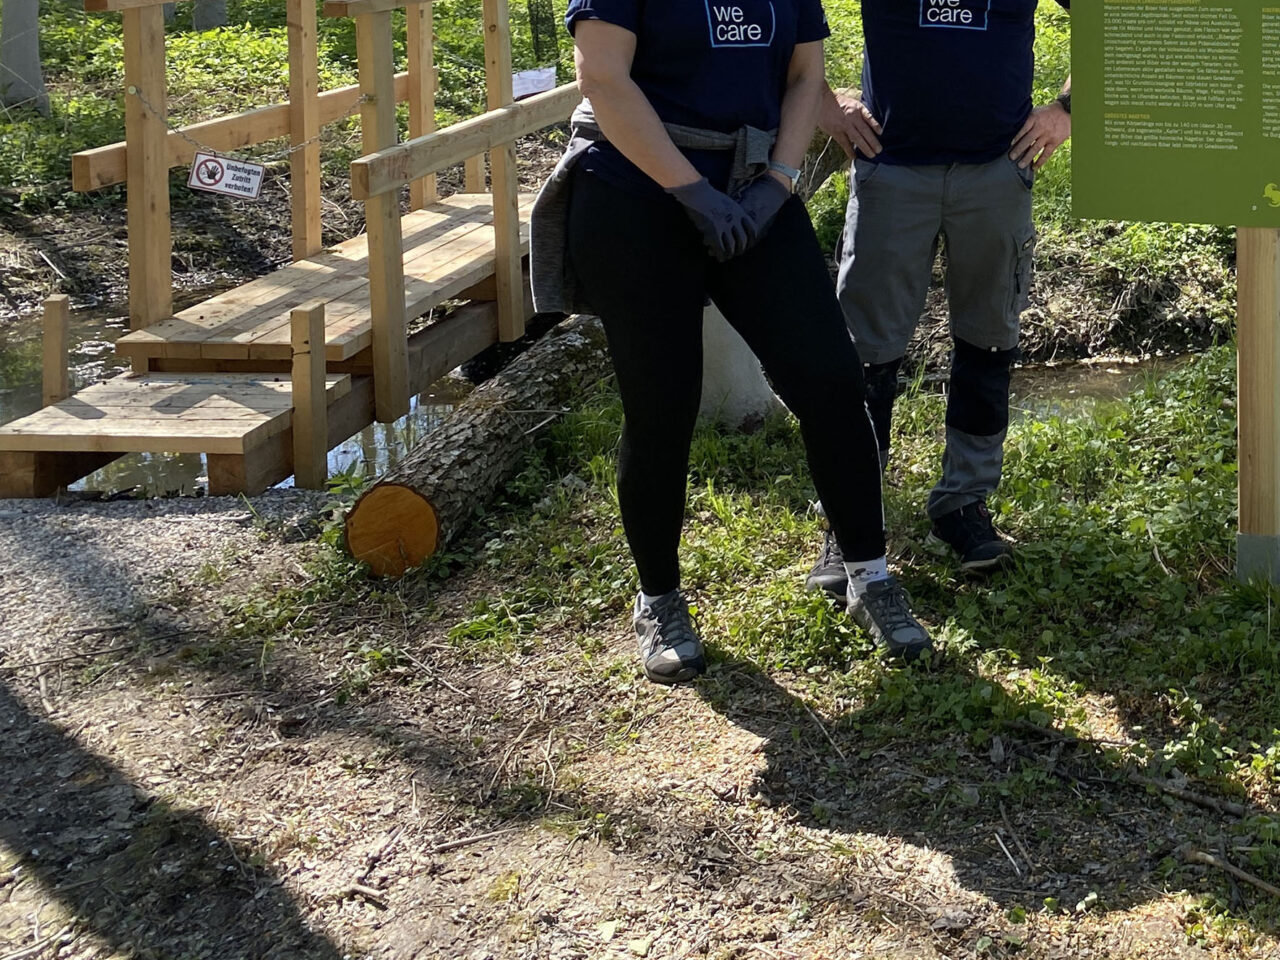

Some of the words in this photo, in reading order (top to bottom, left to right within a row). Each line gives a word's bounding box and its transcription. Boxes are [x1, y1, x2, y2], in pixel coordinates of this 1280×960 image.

[713, 6, 744, 23] we
[927, 7, 973, 23] care
[716, 24, 762, 41] care
[226, 163, 261, 176] Unbefugten
[224, 182, 254, 194] verboten!
